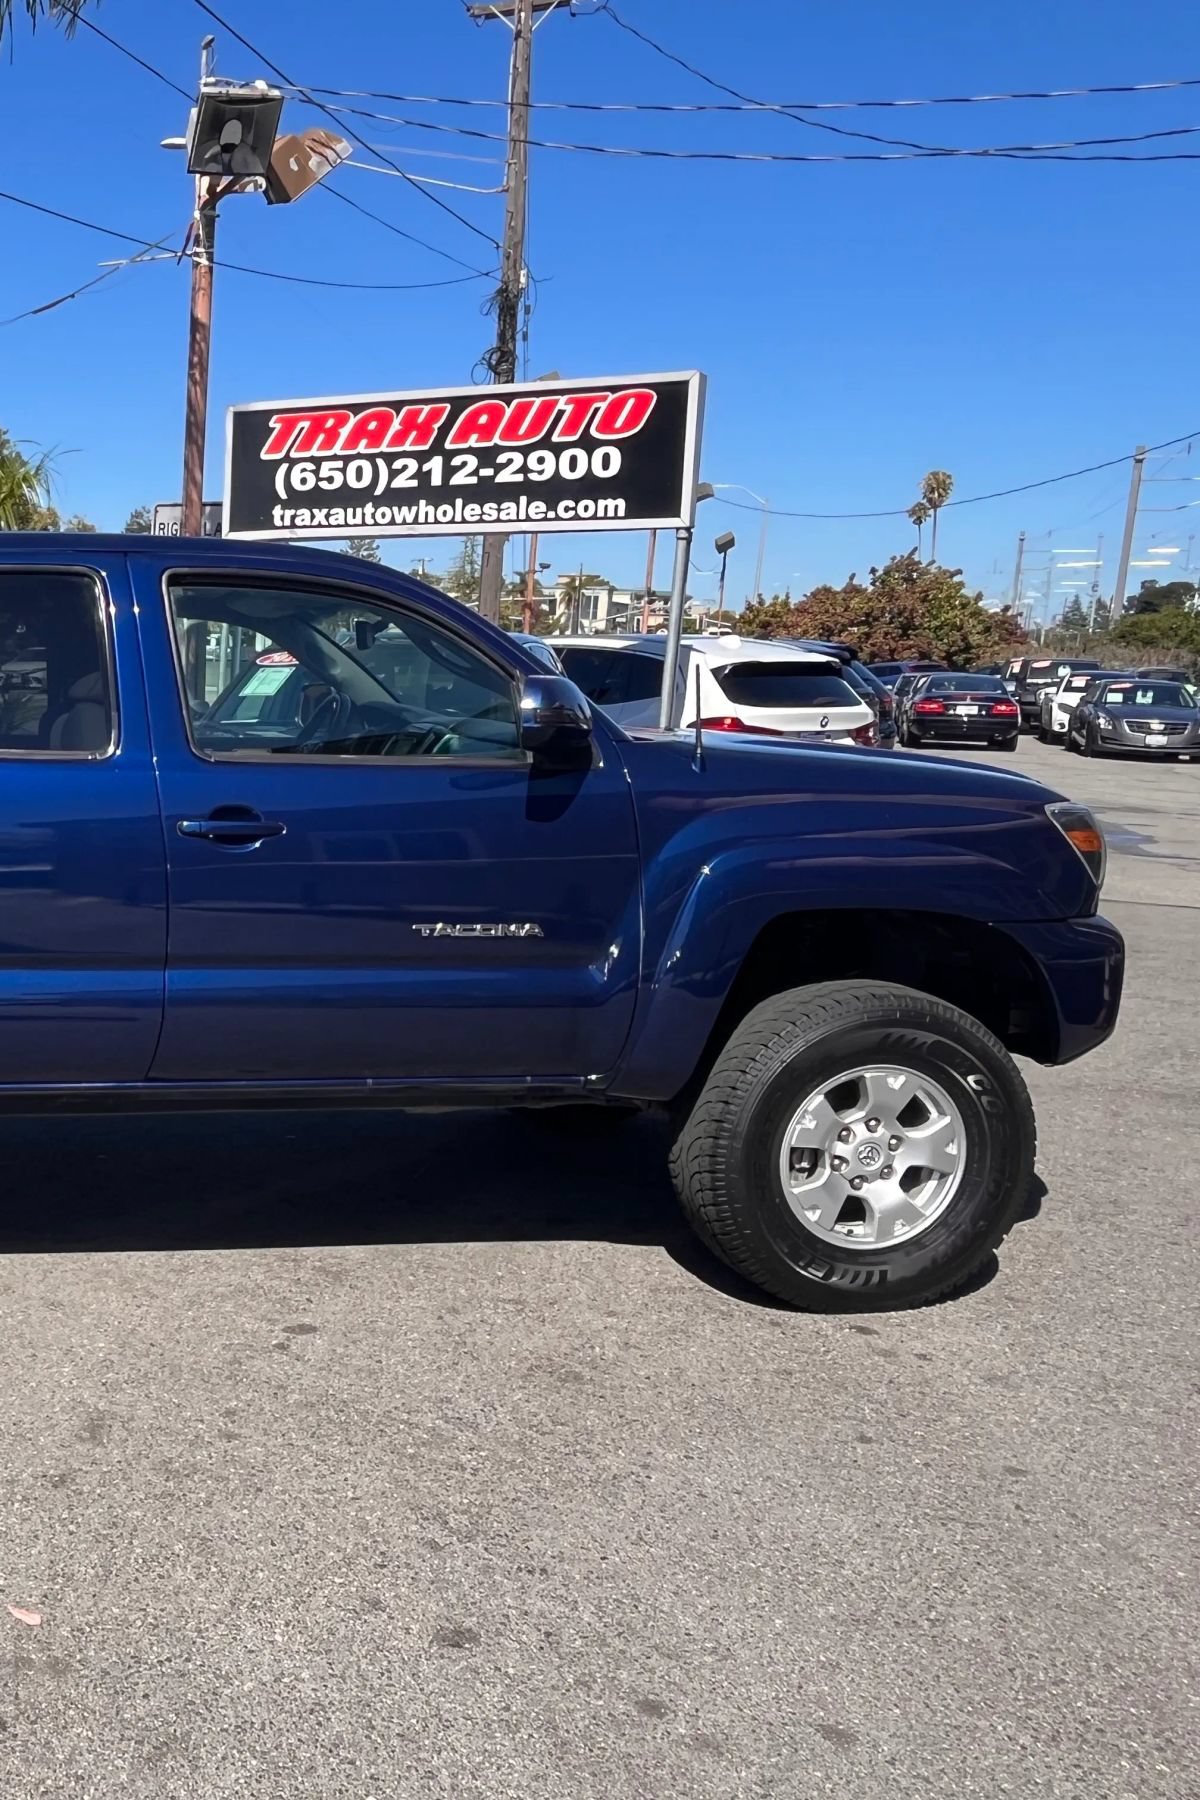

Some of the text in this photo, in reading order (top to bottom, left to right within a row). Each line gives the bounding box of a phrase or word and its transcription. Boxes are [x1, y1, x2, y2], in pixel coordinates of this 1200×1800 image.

[260, 389, 657, 460] TRAX AUTO
[274, 446, 622, 500] (650)212-2900
[272, 495, 626, 527] traxautowholesale.com
[159, 521, 223, 537] RIG LA
[412, 922, 544, 937] TACOMA
